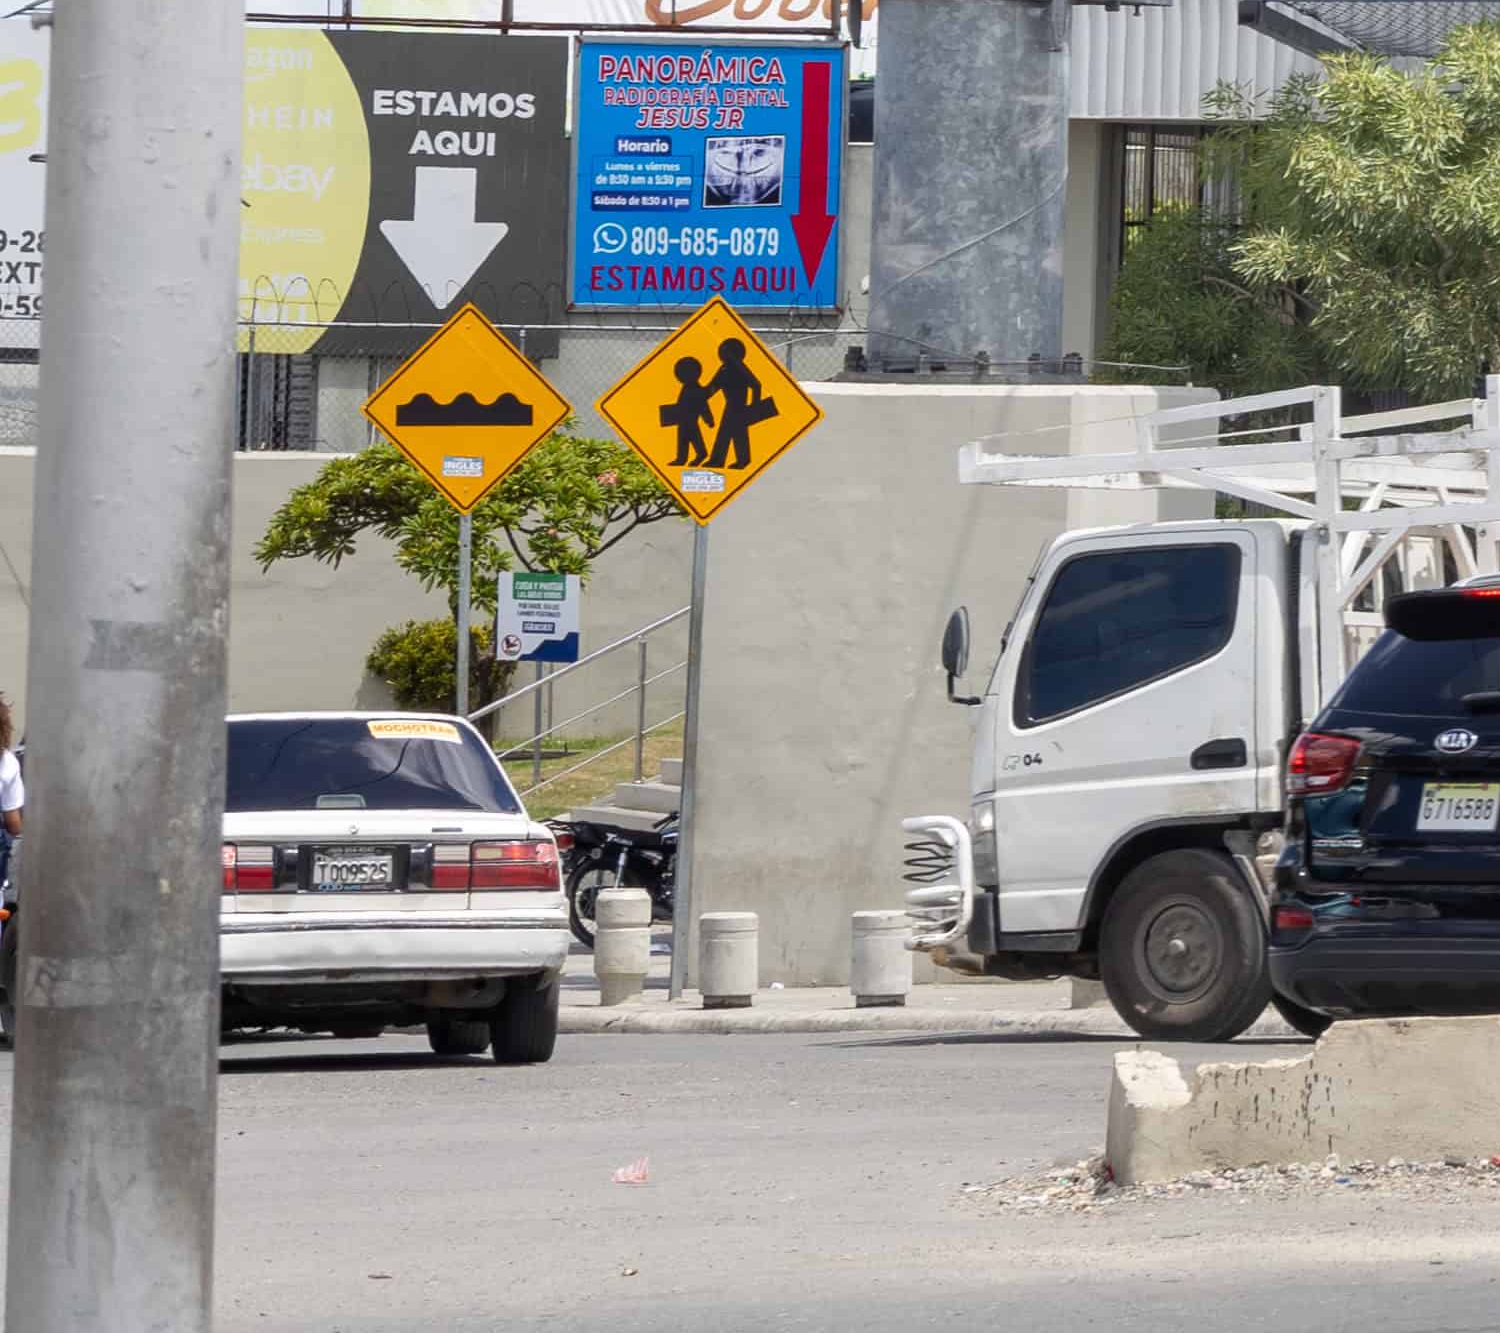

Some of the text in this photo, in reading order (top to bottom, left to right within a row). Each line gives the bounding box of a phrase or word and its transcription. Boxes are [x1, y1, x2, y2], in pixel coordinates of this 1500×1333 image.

[598, 50, 785, 84] PANORÁMICA
[373, 90, 536, 118] ESTAMOS
[604, 86, 788, 108] RADIOGRAFÍA DENTAL
[636, 107, 744, 129] JESUS JR
[408, 130, 496, 156] AQUI
[617, 138, 669, 153] Horario
[631, 226, 779, 256] 809-685-0879
[590, 265, 796, 292] ESTAMOS AQUI
[444, 460, 482, 471] INGLES
[682, 474, 723, 486] INGLES
[1437, 733, 1470, 748] KIA
[1423, 798, 1494, 821] G716588
[318, 862, 389, 882] T009525
